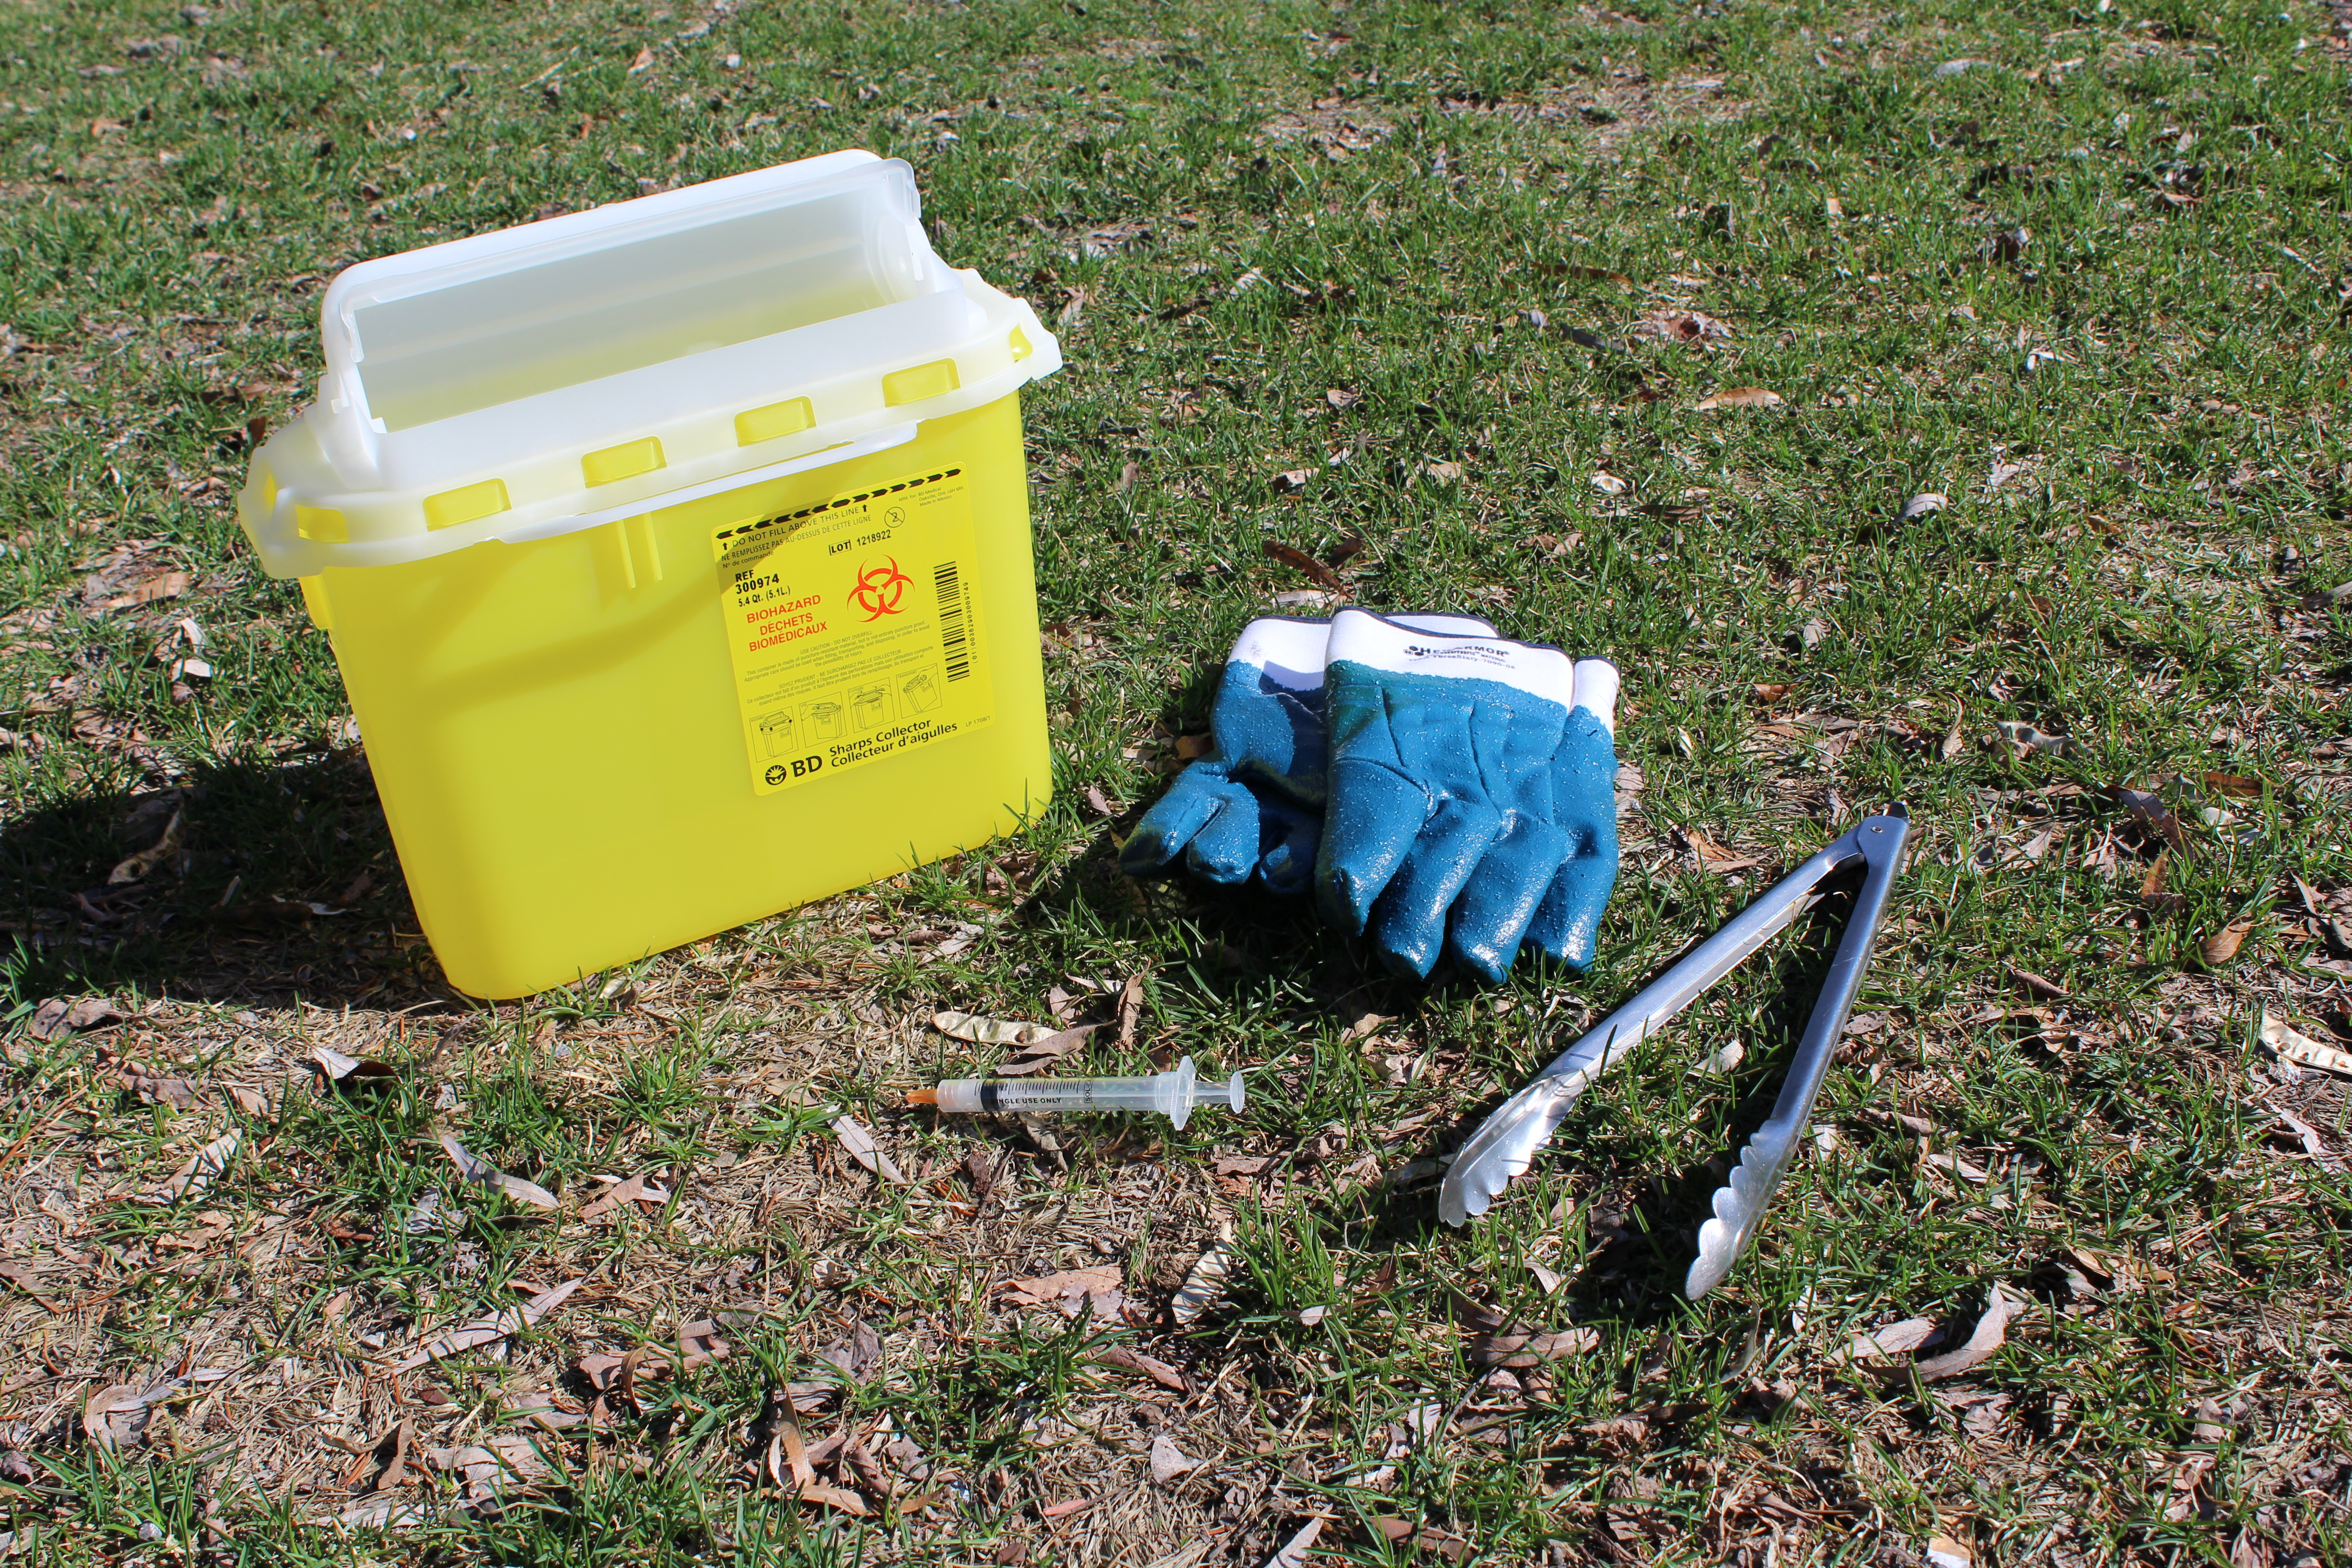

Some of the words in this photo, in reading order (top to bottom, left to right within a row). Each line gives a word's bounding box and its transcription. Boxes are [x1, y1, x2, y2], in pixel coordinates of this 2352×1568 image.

[732, 538, 745, 547] DO
[748, 532, 766, 543] NOT
[769, 527, 786, 537] FILL
[789, 518, 817, 532] ABOVE
[820, 512, 838, 523] THIS
[841, 507, 859, 517] LINE
[732, 543, 770, 558] REMPLISSEZ
[771, 539, 783, 548] PAS
[785, 529, 820, 544] AU-DESSUS
[833, 520, 851, 531] CETTE
[853, 514, 871, 525] LIGNE
[831, 541, 849, 553] LOT
[857, 529, 891, 546] 1218922
[741, 551, 774, 564] commande
[735, 569, 754, 582] REF
[735, 573, 779, 594] 300974
[739, 597, 750, 607] 5.4
[752, 594, 763, 603] Qt.
[766, 586, 790, 601] (5.1L.)
[747, 595, 821, 623] BIOHAZARD
[749, 621, 828, 652] BIOMÉDICAUX
[760, 612, 813, 636] DÉCHETS
[963, 582, 978, 664] (01)00382903009749
[757, 664, 777, 673] container
[800, 646, 839, 661] puncture-resistant
[839, 640, 858, 649] material,
[894, 625, 913, 634] puncture
[810, 642, 830, 652] CAUTION
[852, 630, 872, 640] OVERFILL
[745, 672, 769, 682] Appropriate
[780, 664, 794, 672] should
[838, 644, 866, 655] transporting,
[875, 635, 896, 644] disposing,
[779, 681, 794, 689] SOYEZ
[794, 674, 815, 684] PRUDENT
[826, 662, 857, 675] SURCHARGEZ
[873, 649, 902, 661] COLLECTEUR
[823, 656, 844, 666] possibility
[754, 693, 774, 702] collecteur
[800, 680, 816, 689] produit
[848, 664, 873, 675] perforations
[893, 652, 913, 661] utilisation
[914, 646, 933, 655] comporte
[759, 698, 772, 706] quand
[835, 675, 851, 684] prudent
[900, 655, 919, 664] transport
[897, 670, 916, 678] TRANSPORT
[974, 715, 990, 724] 1708/1
[830, 738, 872, 757] Sharps
[876, 720, 931, 742] Collector
[831, 742, 894, 767] Collecteur
[898, 723, 957, 747] d'aigulles
[790, 755, 822, 777] BD
